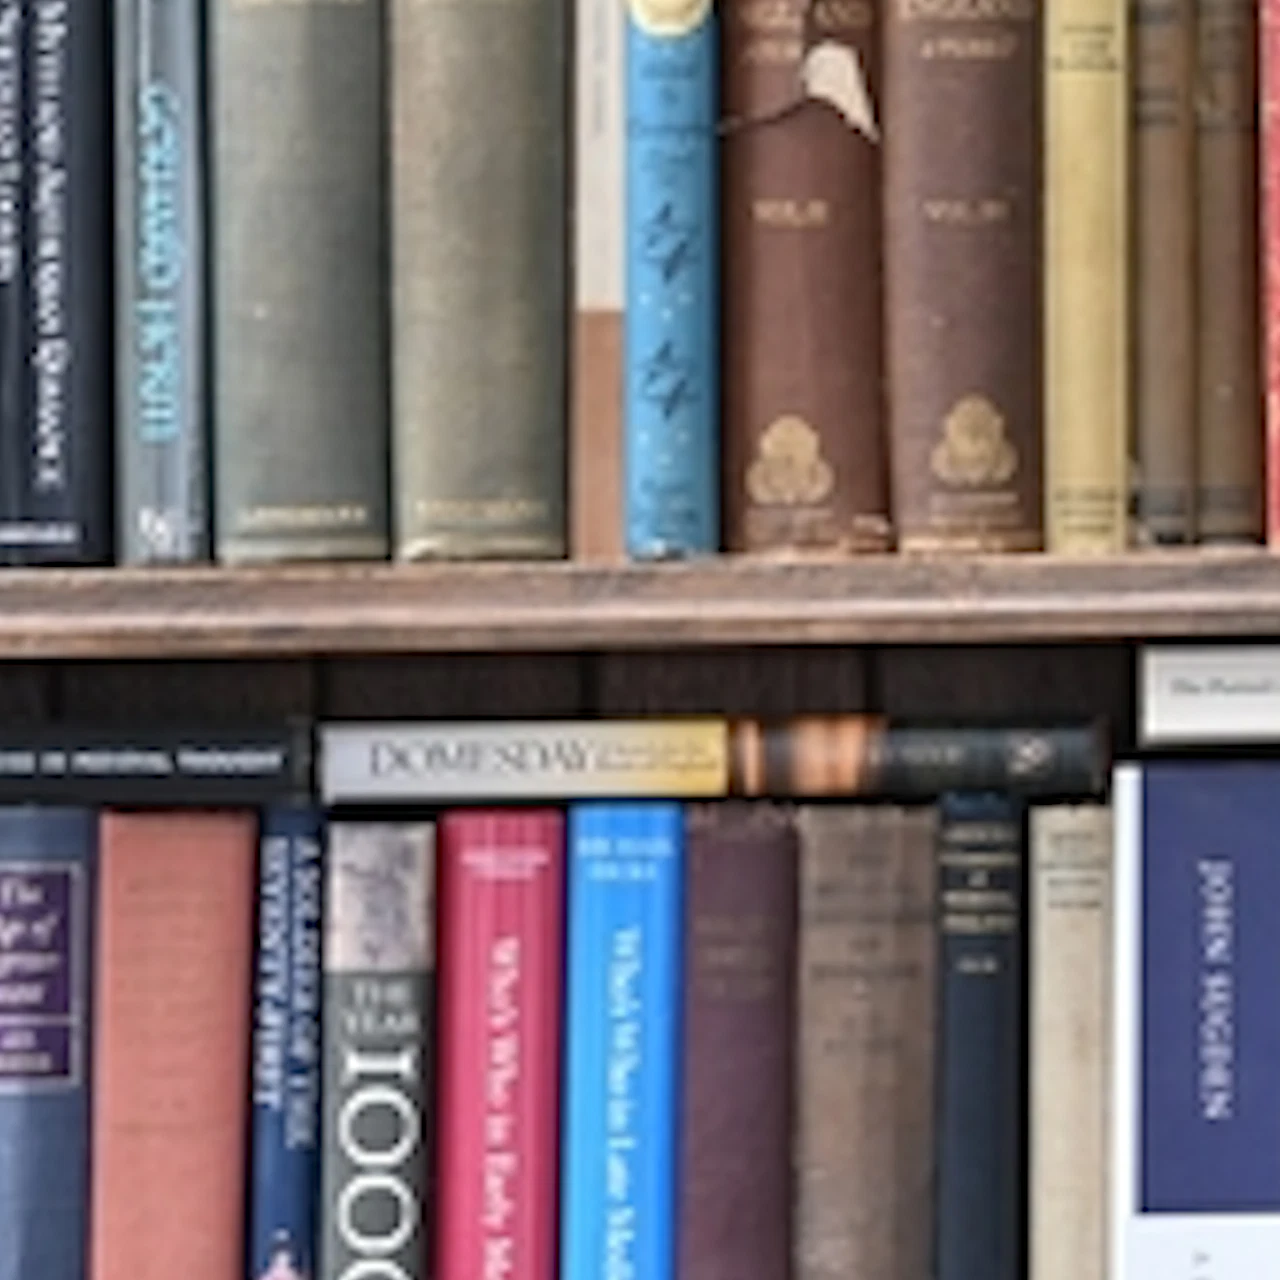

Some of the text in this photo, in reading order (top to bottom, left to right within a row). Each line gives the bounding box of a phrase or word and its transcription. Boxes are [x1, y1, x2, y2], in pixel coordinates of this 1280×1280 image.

[368, 736, 592, 782] DOMESDAY
[284, 857, 317, 1008] SOLDIER
[487, 935, 520, 1028] Who's
[608, 926, 639, 1015] Who's
[1198, 859, 1232, 1120] JOHN SUGDEN
[284, 1023, 317, 1064] OF
[486, 1035, 519, 1105] Who
[607, 1018, 638, 1090] Who
[284, 1075, 317, 1148] THE
[486, 1113, 517, 1142] in
[606, 1092, 635, 1122] in
[479, 1151, 516, 1228] Early
[604, 1133, 636, 1195] Late
